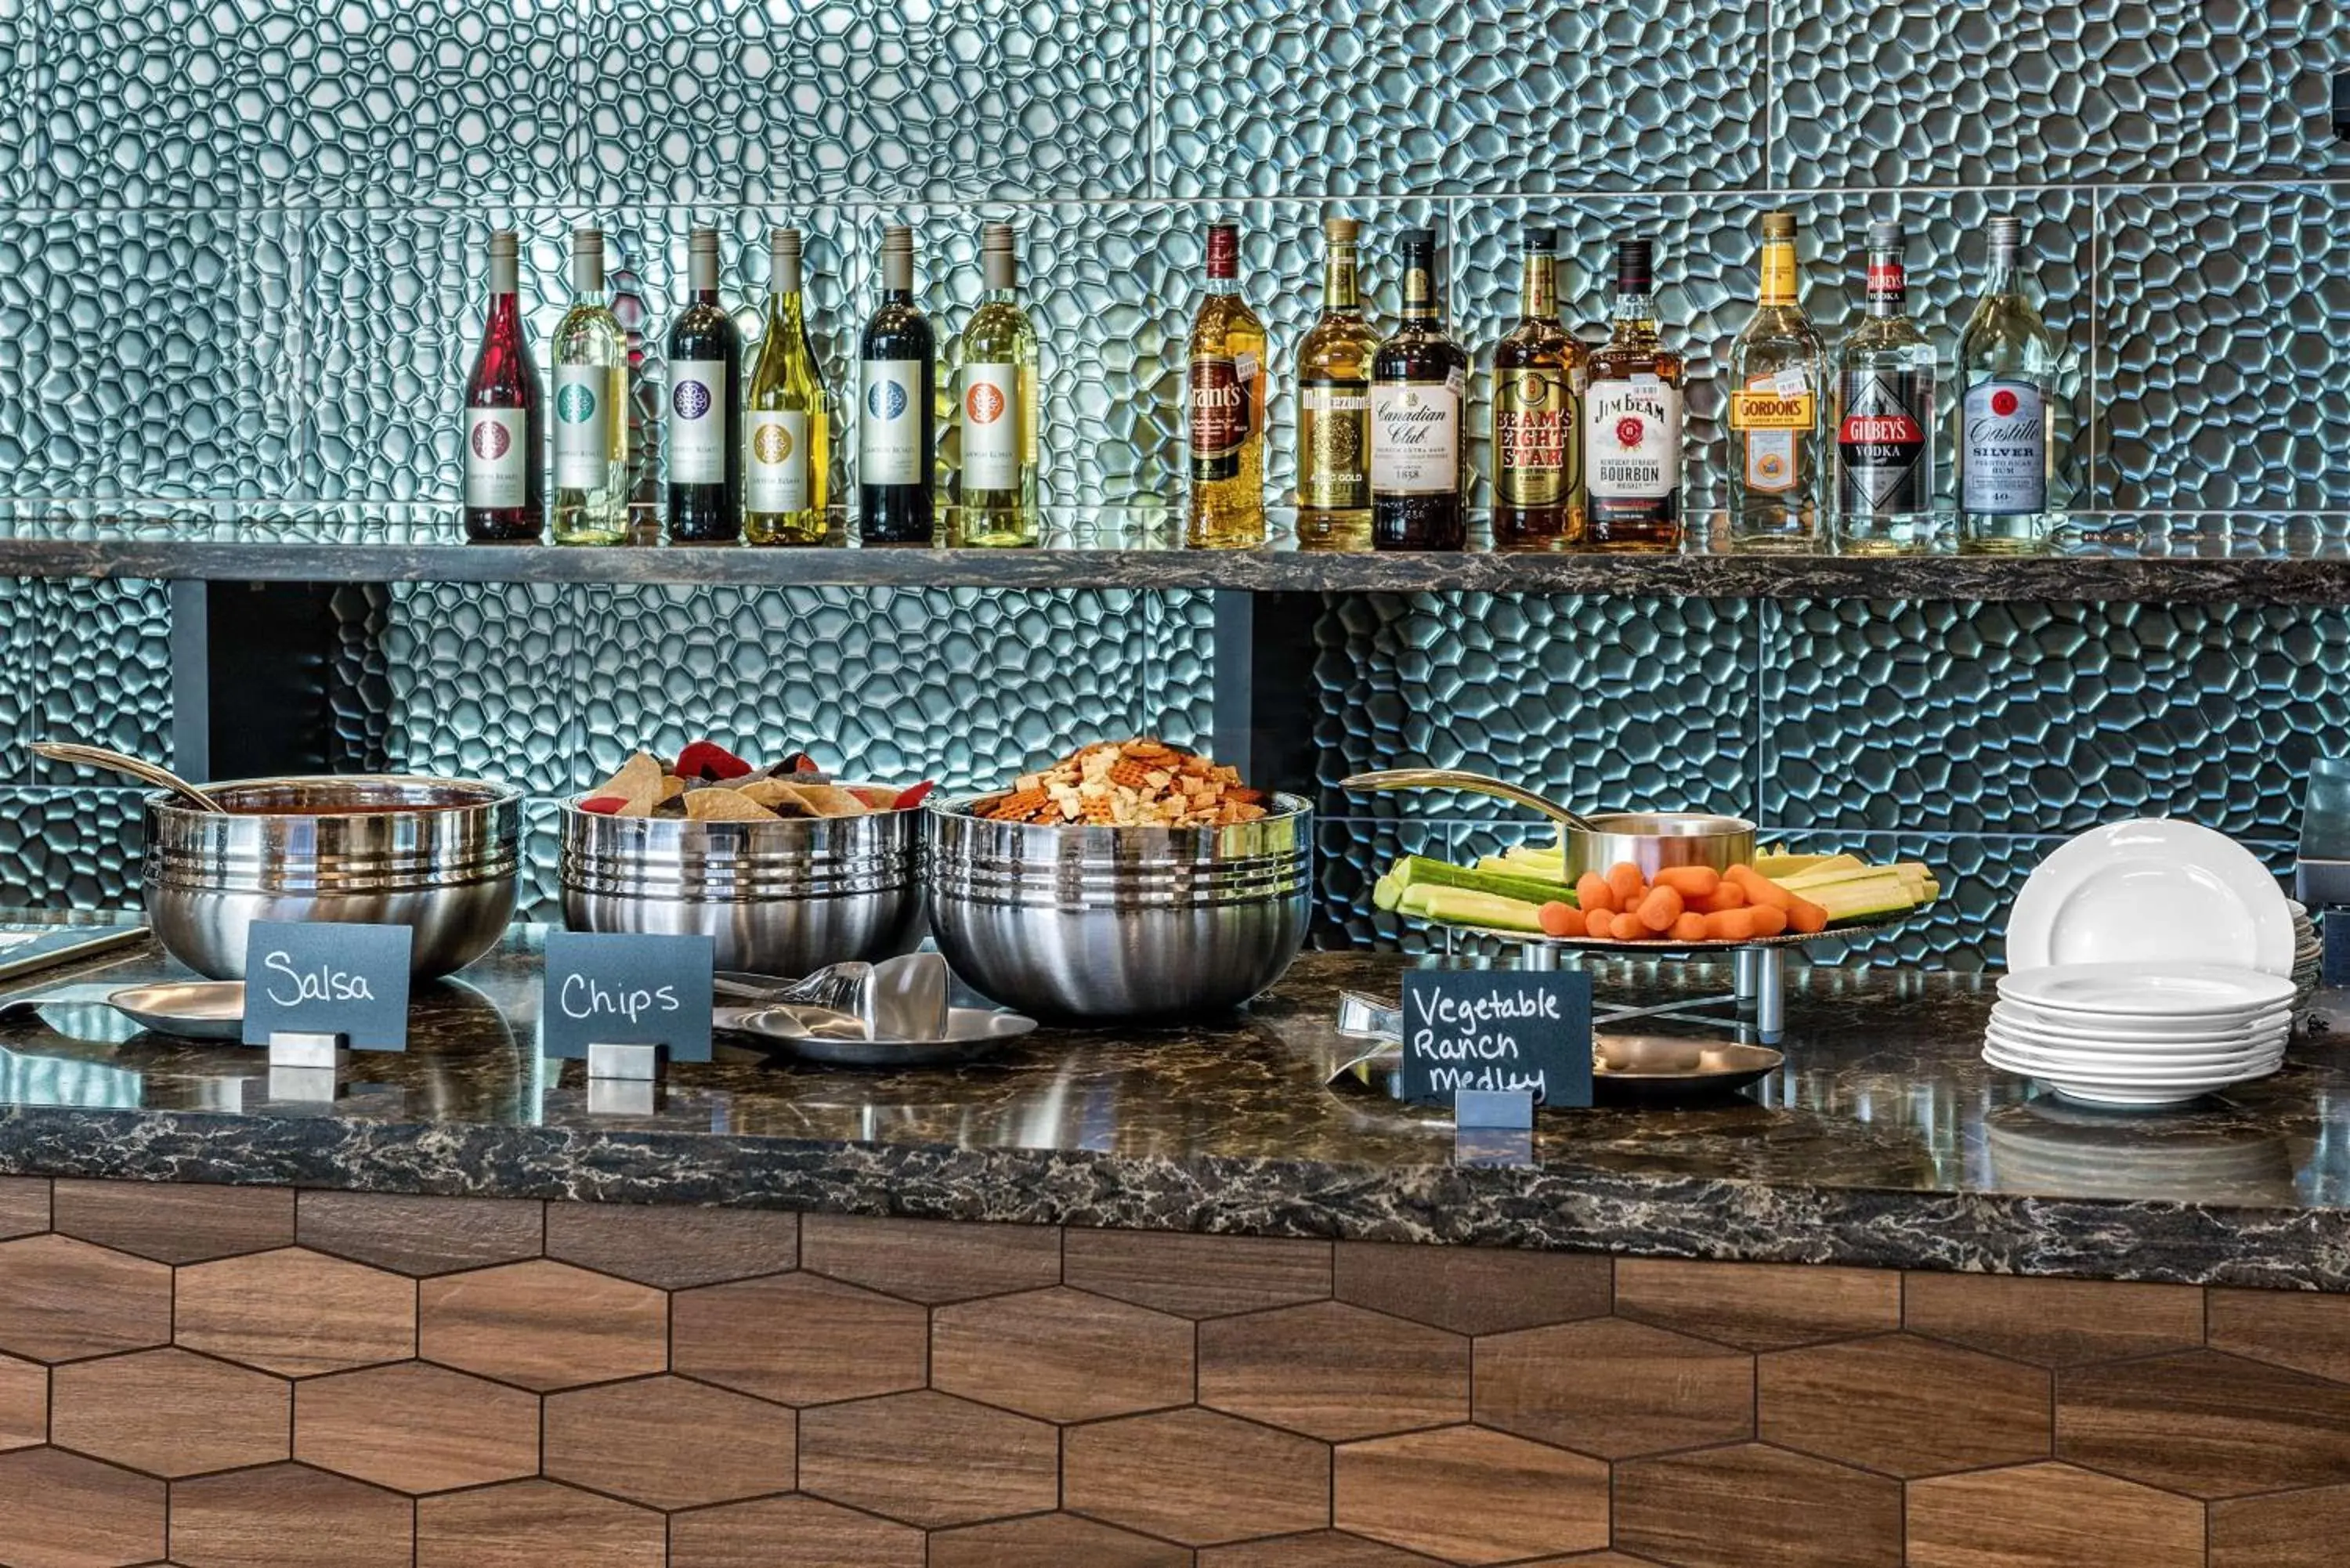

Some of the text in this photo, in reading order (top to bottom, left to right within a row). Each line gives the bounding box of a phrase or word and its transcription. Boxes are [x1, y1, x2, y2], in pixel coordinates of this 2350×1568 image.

[1190, 382, 1241, 407] rant's
[1376, 400, 1447, 422] Canadian
[1497, 407, 1572, 428] BEAM'S
[1594, 399, 1621, 424] JIM
[1625, 392, 1665, 424] BEAM
[1386, 423, 1430, 444] Club
[1502, 428, 1567, 449] EIGHT
[1850, 417, 1906, 440] GILBEY'S
[1503, 448, 1563, 468] STAR
[1855, 444, 1901, 457] VODKA
[1973, 447, 2034, 457] SILVER
[1600, 466, 1659, 482] BOURBON
[265, 951, 375, 1007] Salsa
[561, 974, 680, 1024] Chips
[1412, 986, 1561, 1036] Vegetable
[1414, 1028, 1519, 1060] Ranch
